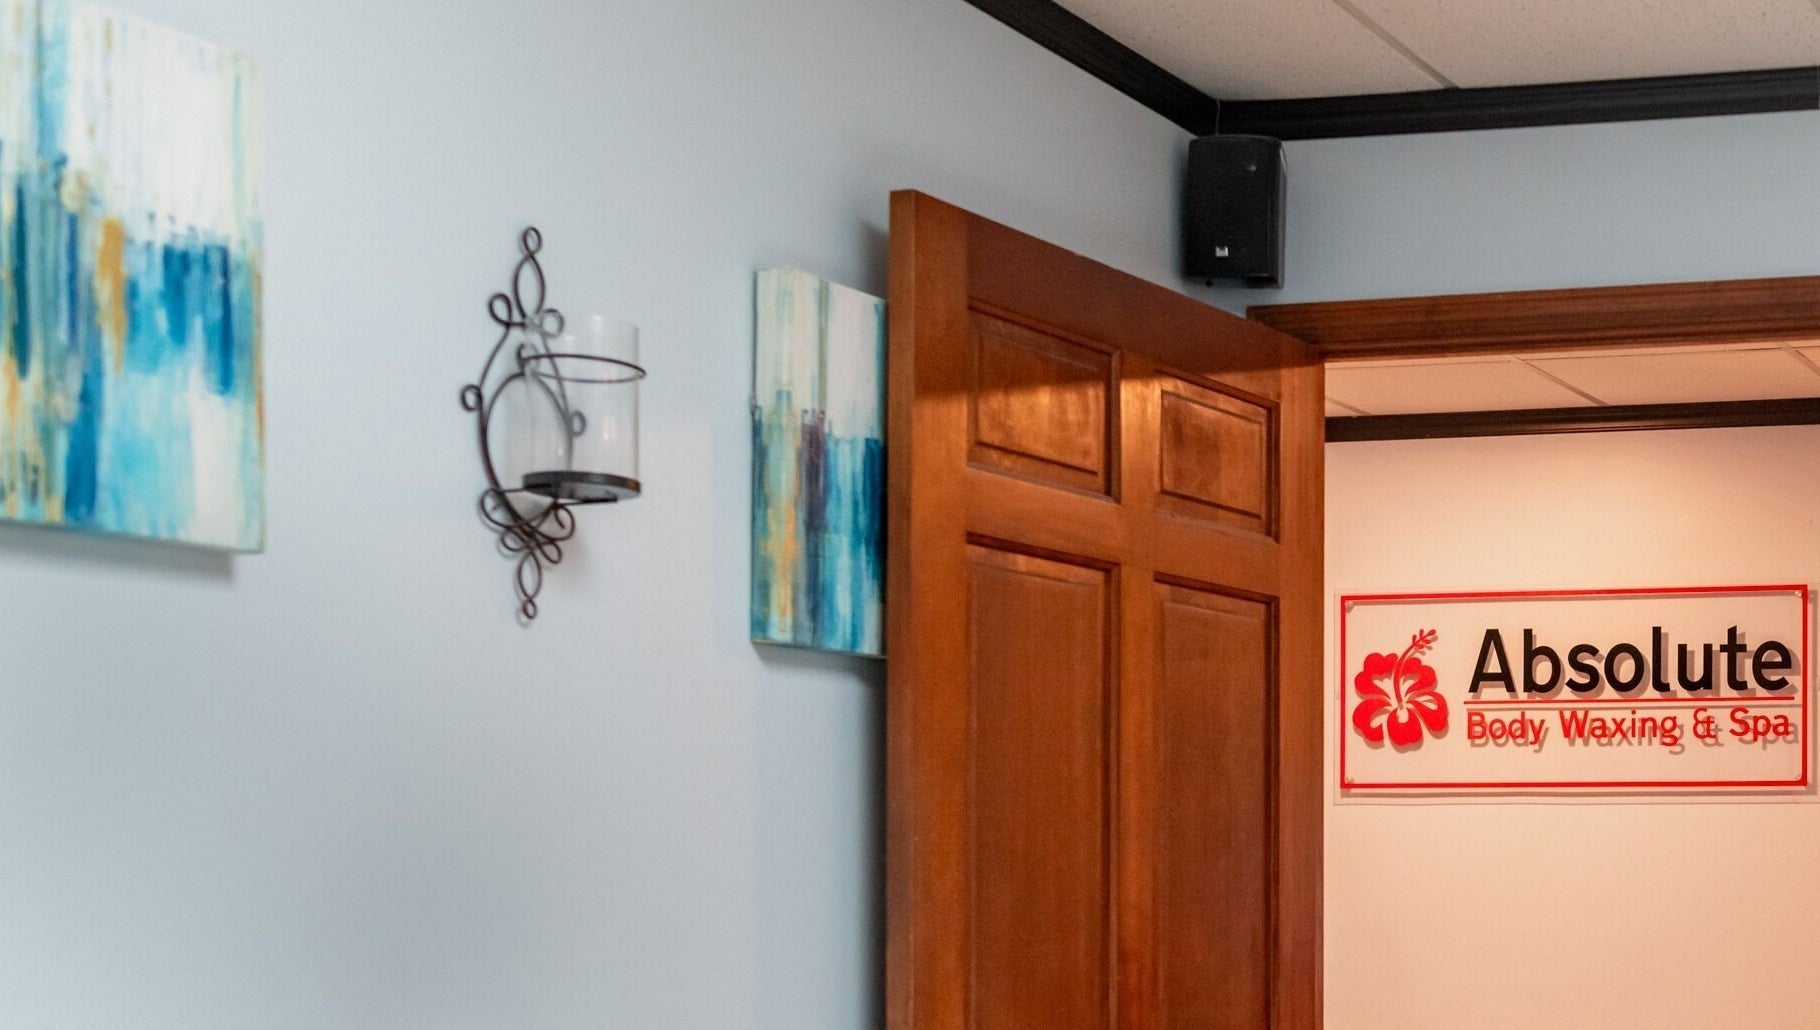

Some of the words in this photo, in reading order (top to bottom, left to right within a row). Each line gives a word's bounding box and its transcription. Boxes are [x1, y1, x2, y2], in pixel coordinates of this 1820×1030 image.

[1468, 624, 1793, 694] Absolute
[1467, 710, 1546, 745] Body
[1558, 709, 1679, 747] Waxing
[1692, 707, 1717, 739] &
[1729, 706, 1790, 743] Spa
